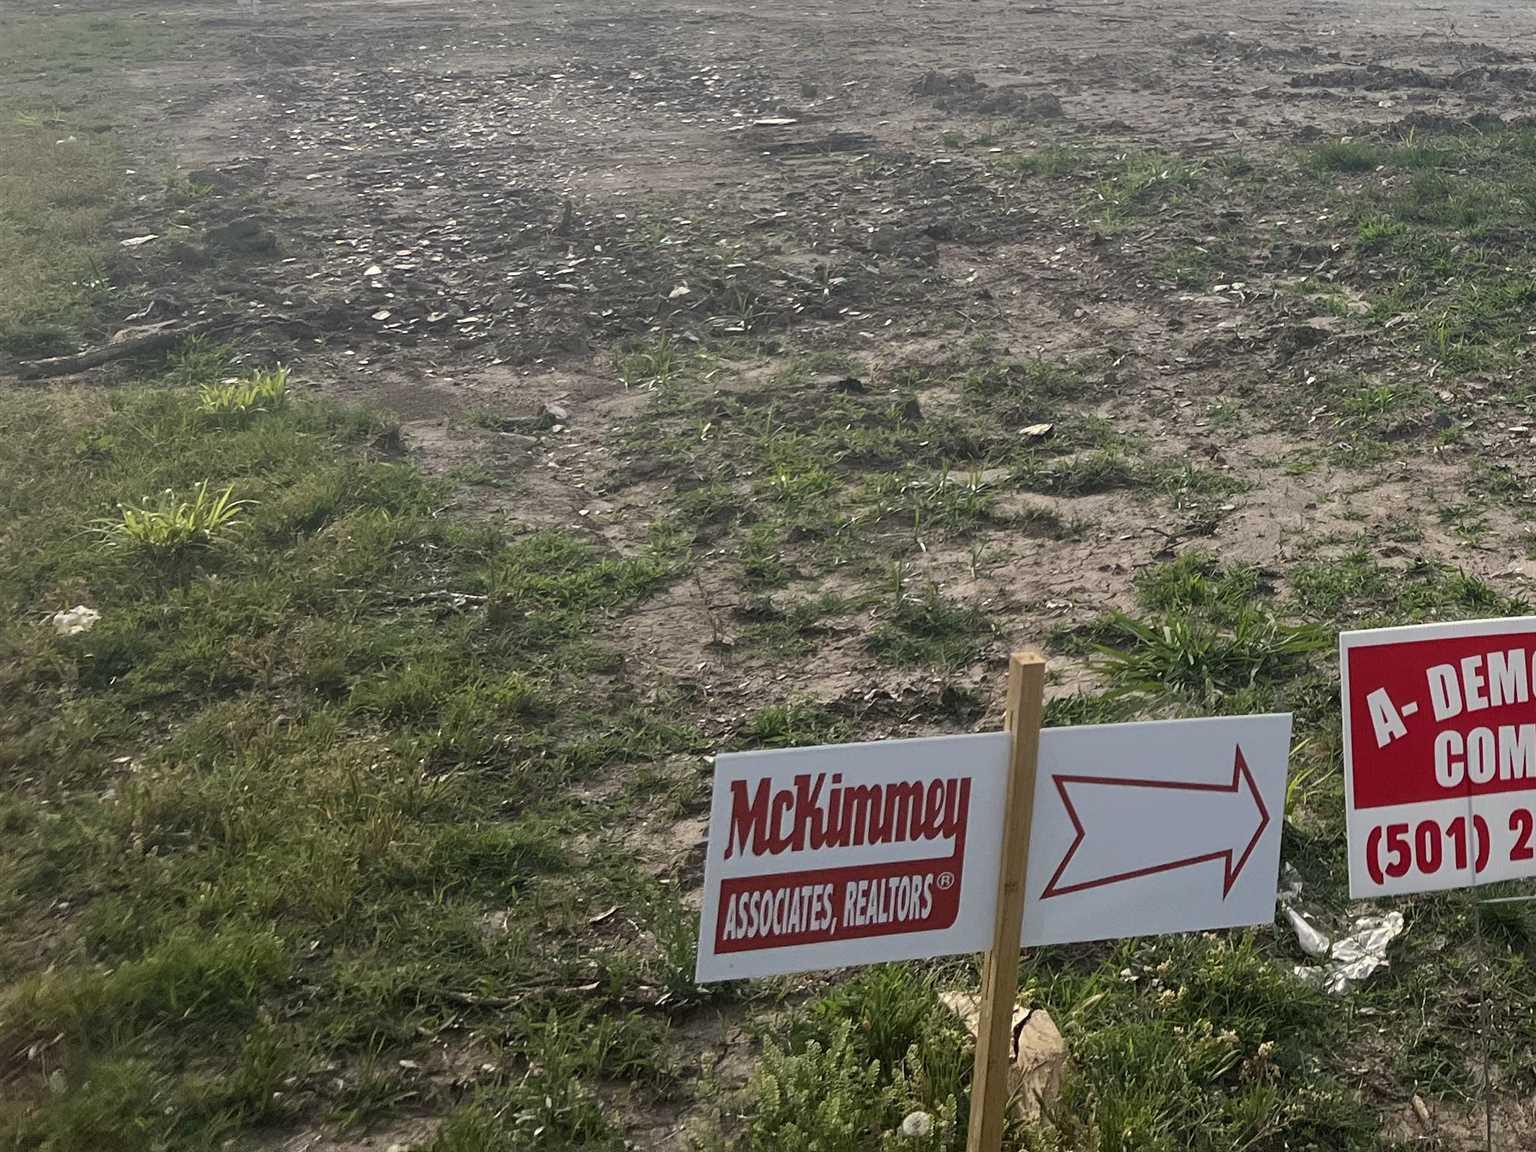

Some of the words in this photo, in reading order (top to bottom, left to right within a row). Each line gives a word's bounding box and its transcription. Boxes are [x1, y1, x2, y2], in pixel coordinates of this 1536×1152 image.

[1367, 687, 1417, 749] A-
[724, 772, 972, 860] McKimmey
[1366, 814, 1491, 885] (501)
[723, 883, 838, 940] ASSOCIATES,
